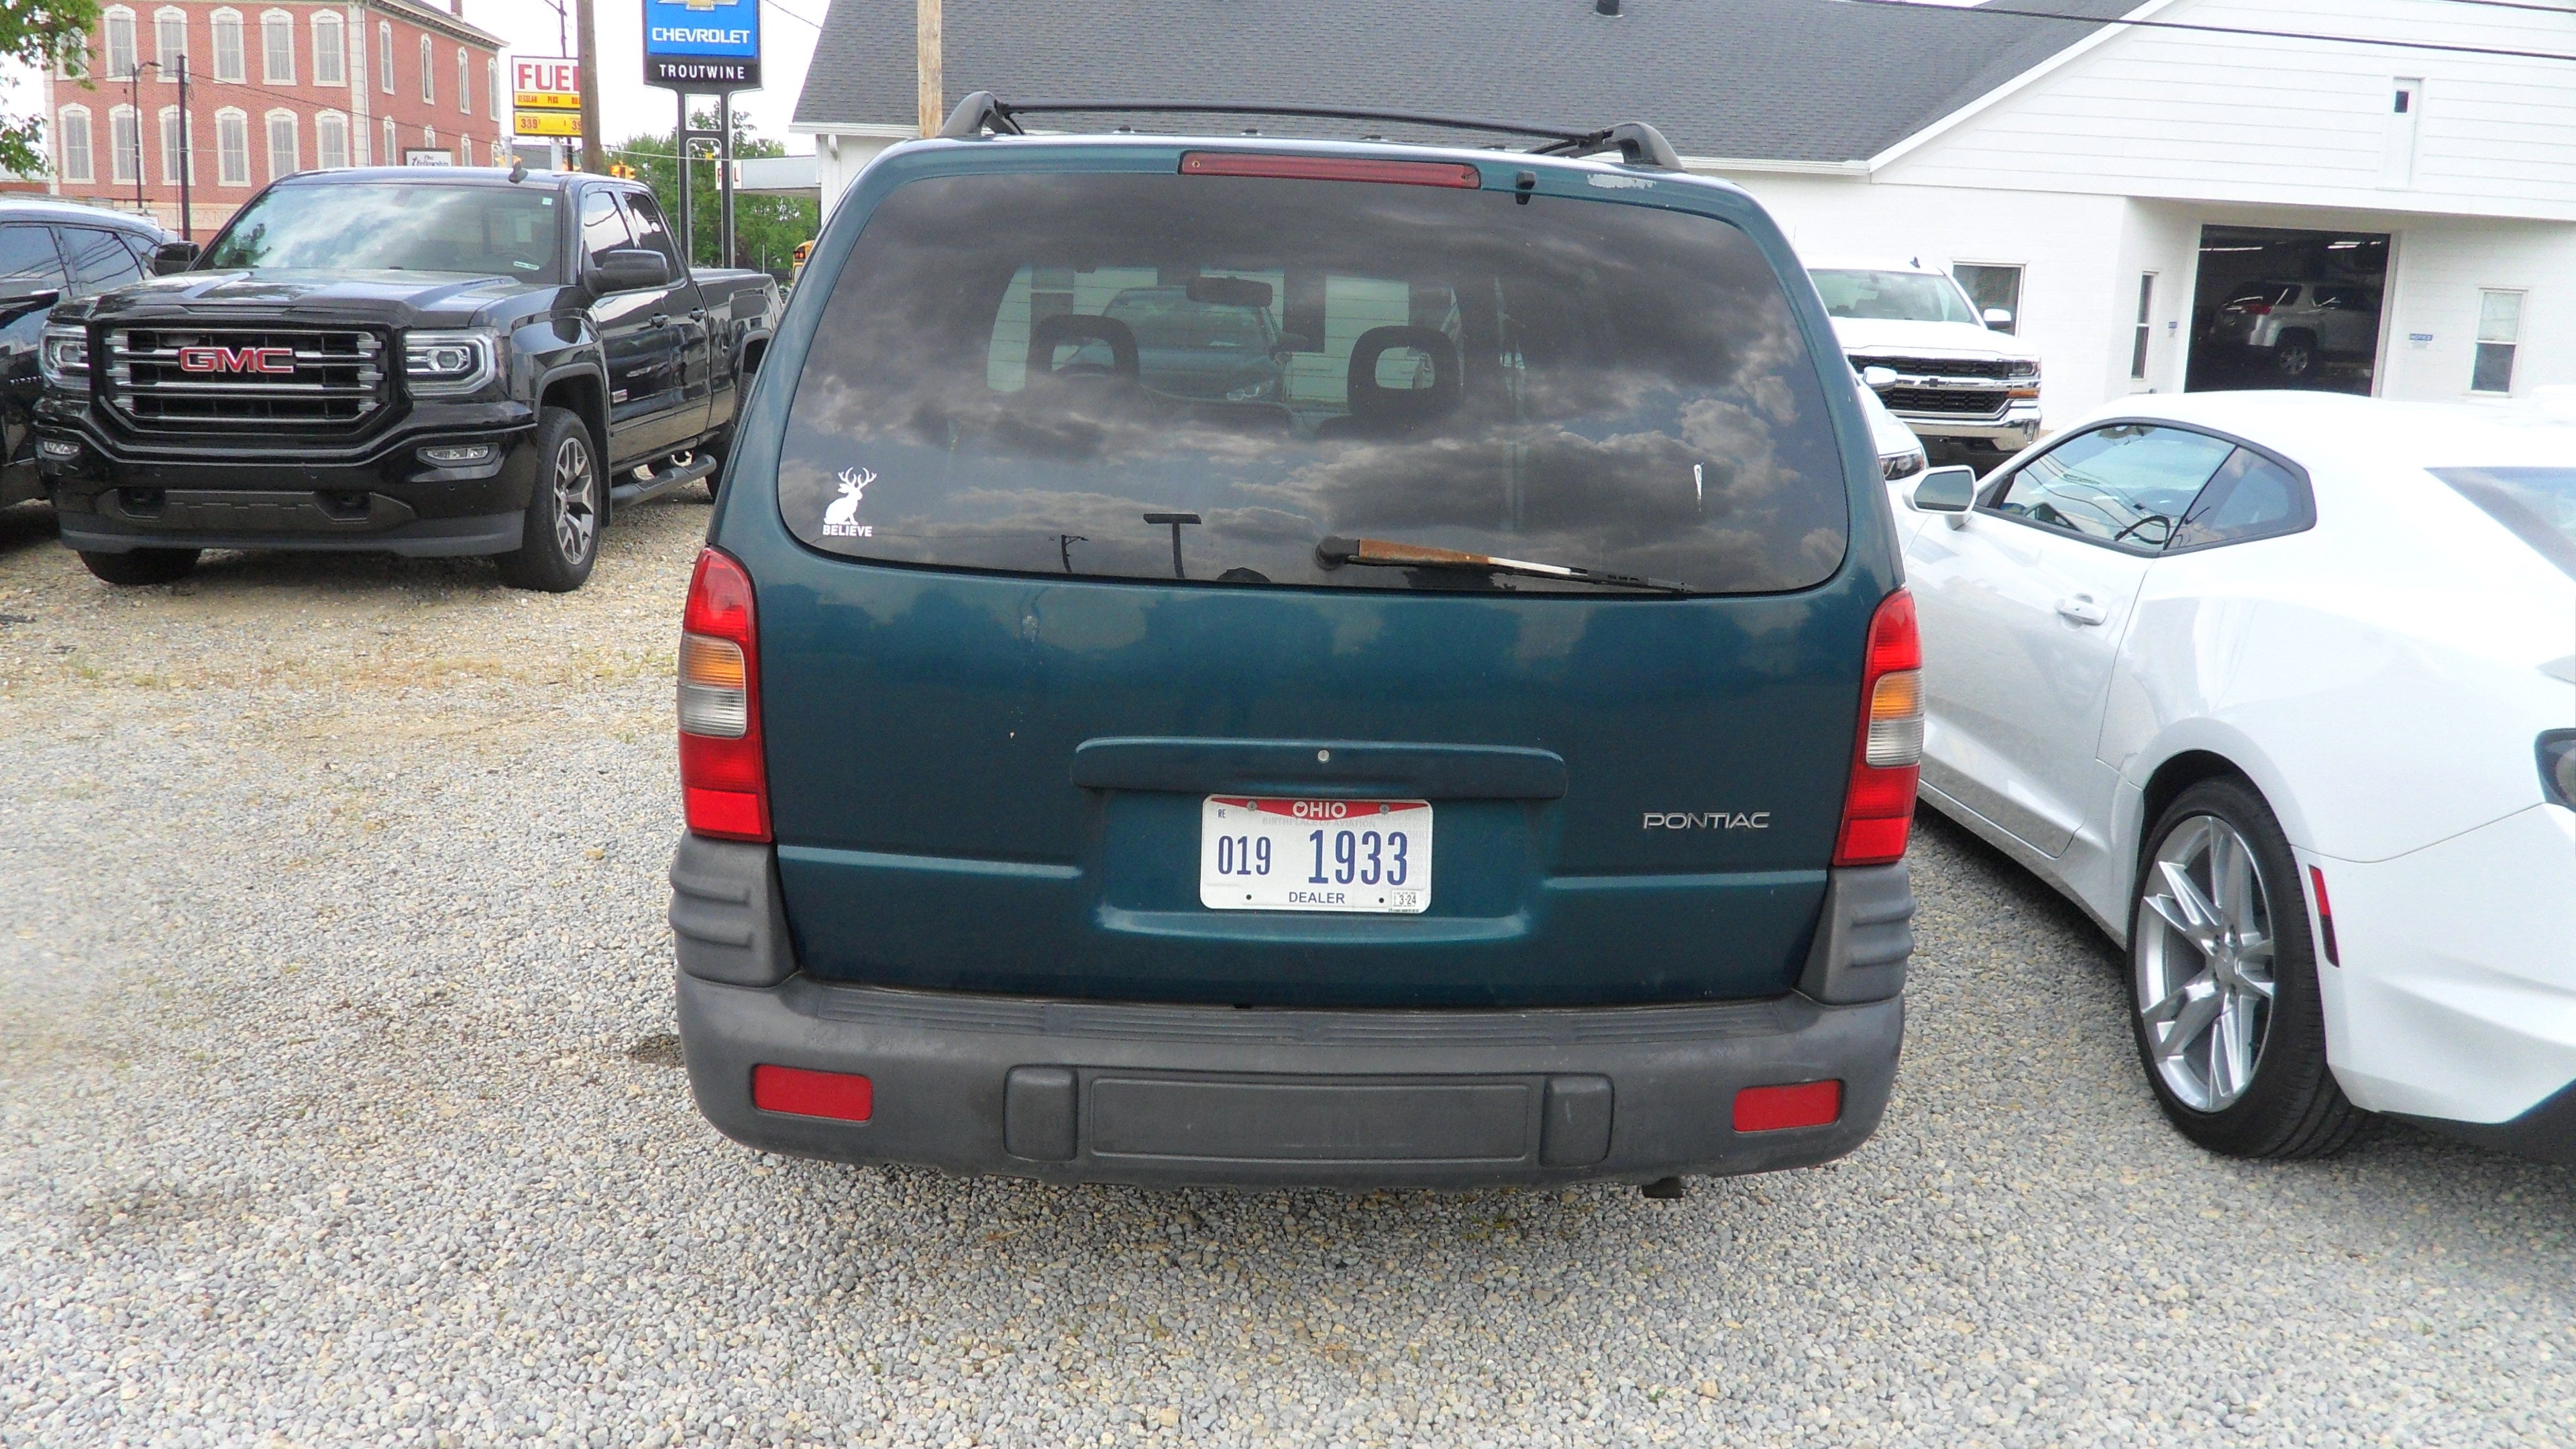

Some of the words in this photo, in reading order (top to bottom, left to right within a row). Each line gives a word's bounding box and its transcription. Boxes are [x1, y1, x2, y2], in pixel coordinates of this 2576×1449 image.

[652, 28, 750, 44] CHEVROLET
[659, 64, 745, 79] TROUTWINE
[521, 119, 538, 129] 339
[180, 346, 294, 374] GMC
[822, 524, 873, 537] BELIEVE
[1218, 809, 1226, 818] RE
[1293, 801, 1347, 818] OHIO
[1262, 816, 1318, 826] BIRTHPLACE
[1334, 818, 1377, 828] AVIATION
[1644, 812, 1770, 829] PONTIAC
[1218, 835, 1271, 875] 019
[1308, 829, 1407, 885] 1933
[1289, 892, 1345, 904] DEALER
[1399, 894, 1417, 905] 3-24
